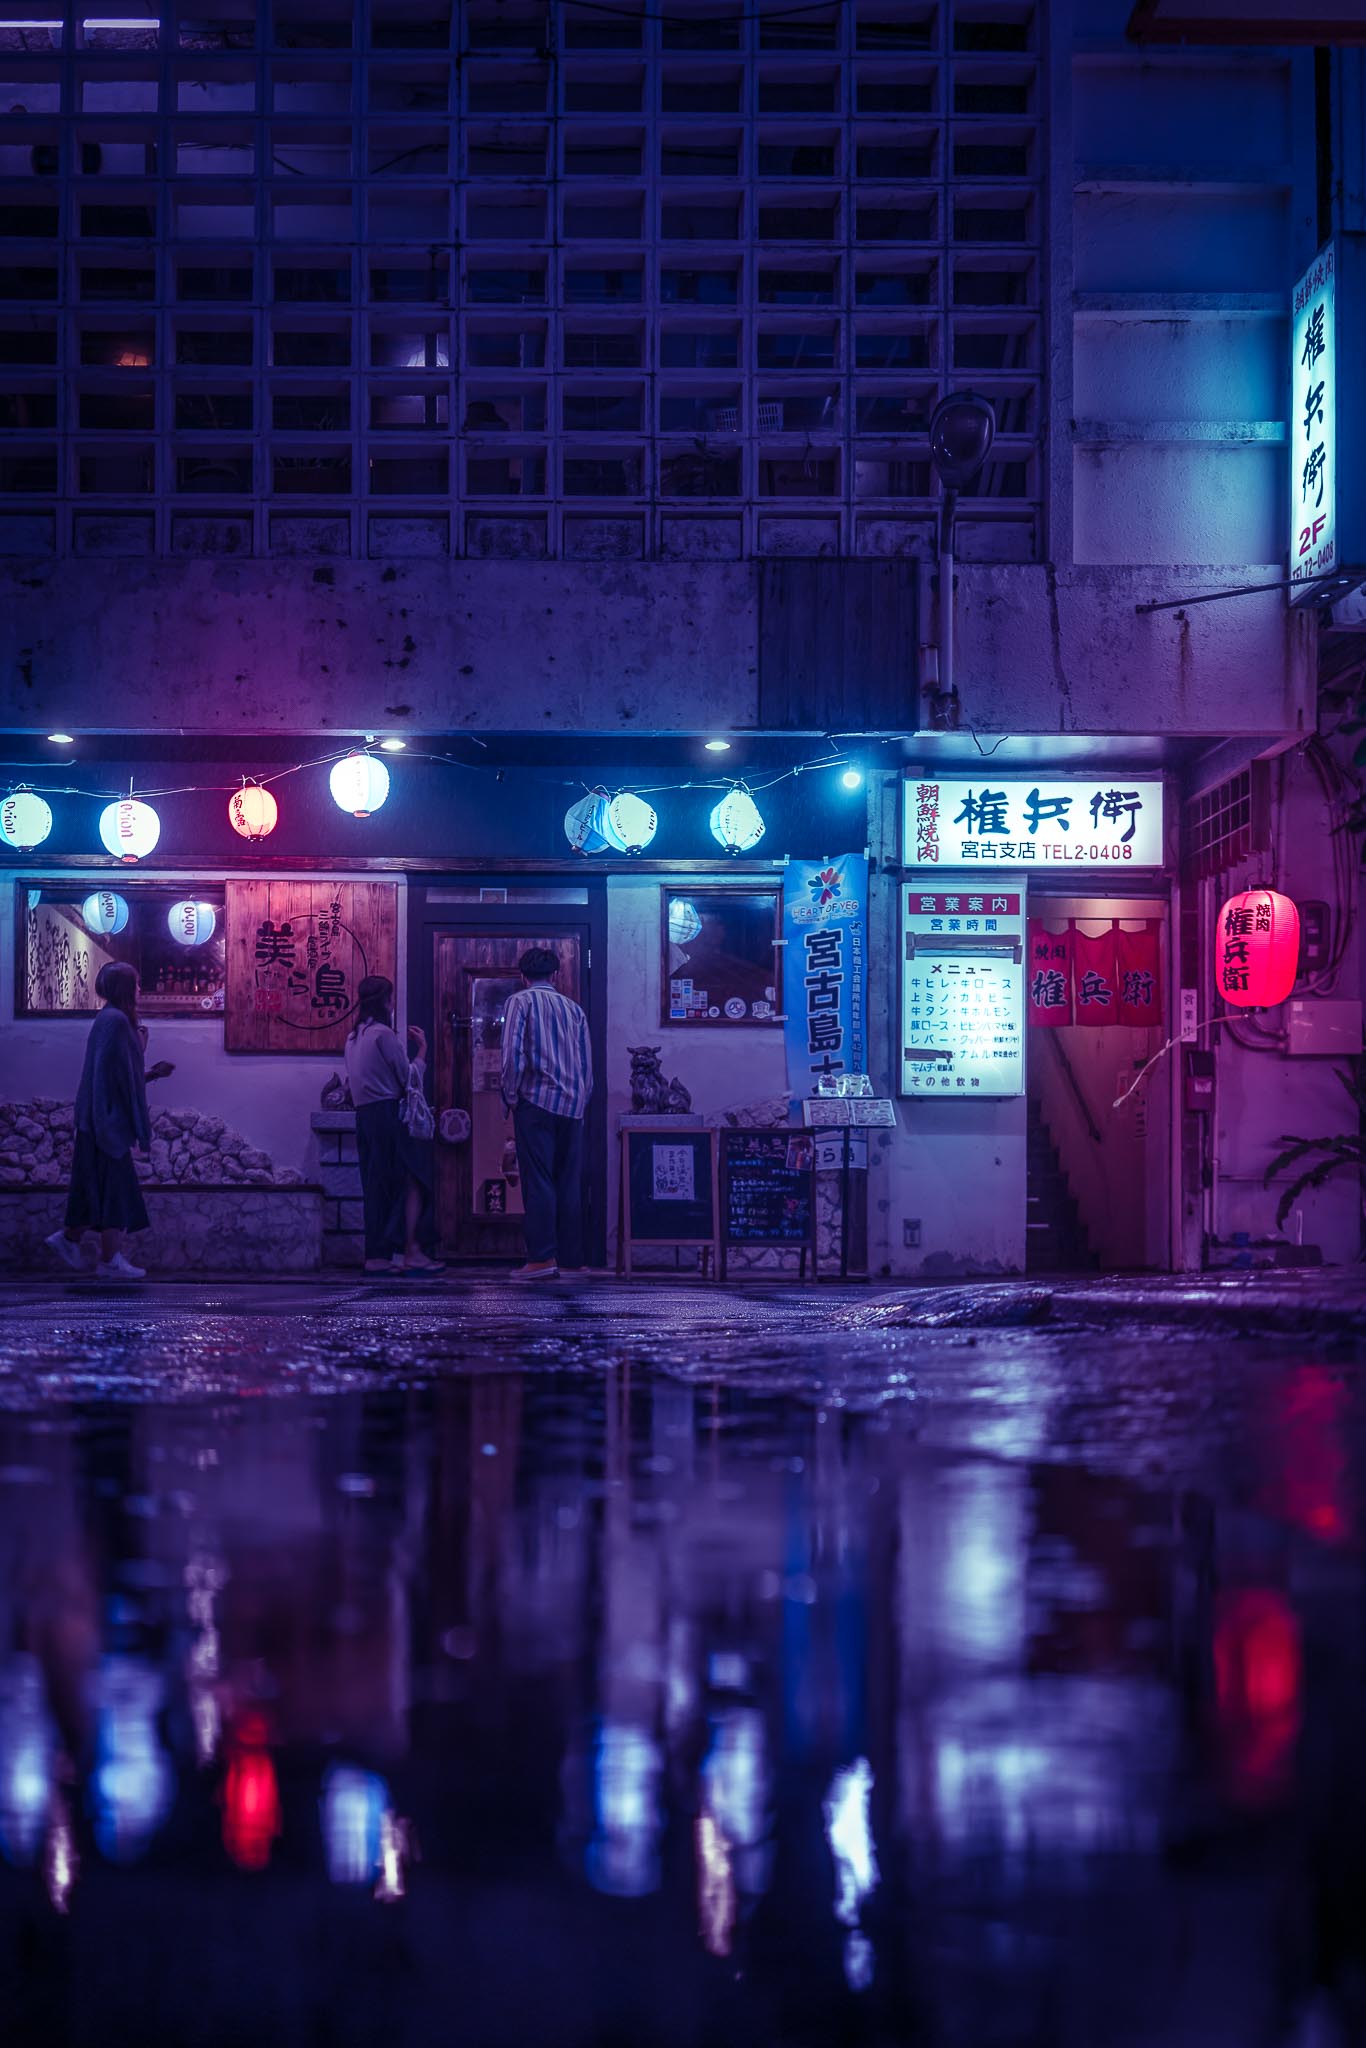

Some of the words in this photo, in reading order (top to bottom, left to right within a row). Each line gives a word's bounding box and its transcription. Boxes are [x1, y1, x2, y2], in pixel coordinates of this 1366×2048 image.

[1301, 303, 1326, 509] 権兵衛
[1299, 512, 1327, 557] 2F
[4, 801, 17, 834] Orion
[120, 803, 136, 838] Orion
[916, 783, 940, 862] 朝鮮焼肉
[953, 787, 1143, 842] 権兵衛
[961, 841, 1036, 860] 宮古支店
[1043, 844, 1133, 860] TEL2-0408
[793, 906, 825, 917] HEART
[826, 902, 838, 913] OF
[840, 900, 858, 910] YEG
[920, 895, 1008, 912] 営業案内
[1256, 903, 1272, 932] 焼肉
[930, 918, 998, 932] 営業時間
[1222, 907, 1254, 992] 権兵衛
[911, 978, 1012, 989] 牛ヒレ・牛ロース
[930, 964, 993, 975] メニュー
[1032, 968, 1156, 1008] 権兵衛
[911, 1076, 980, 1087] その他飲物
